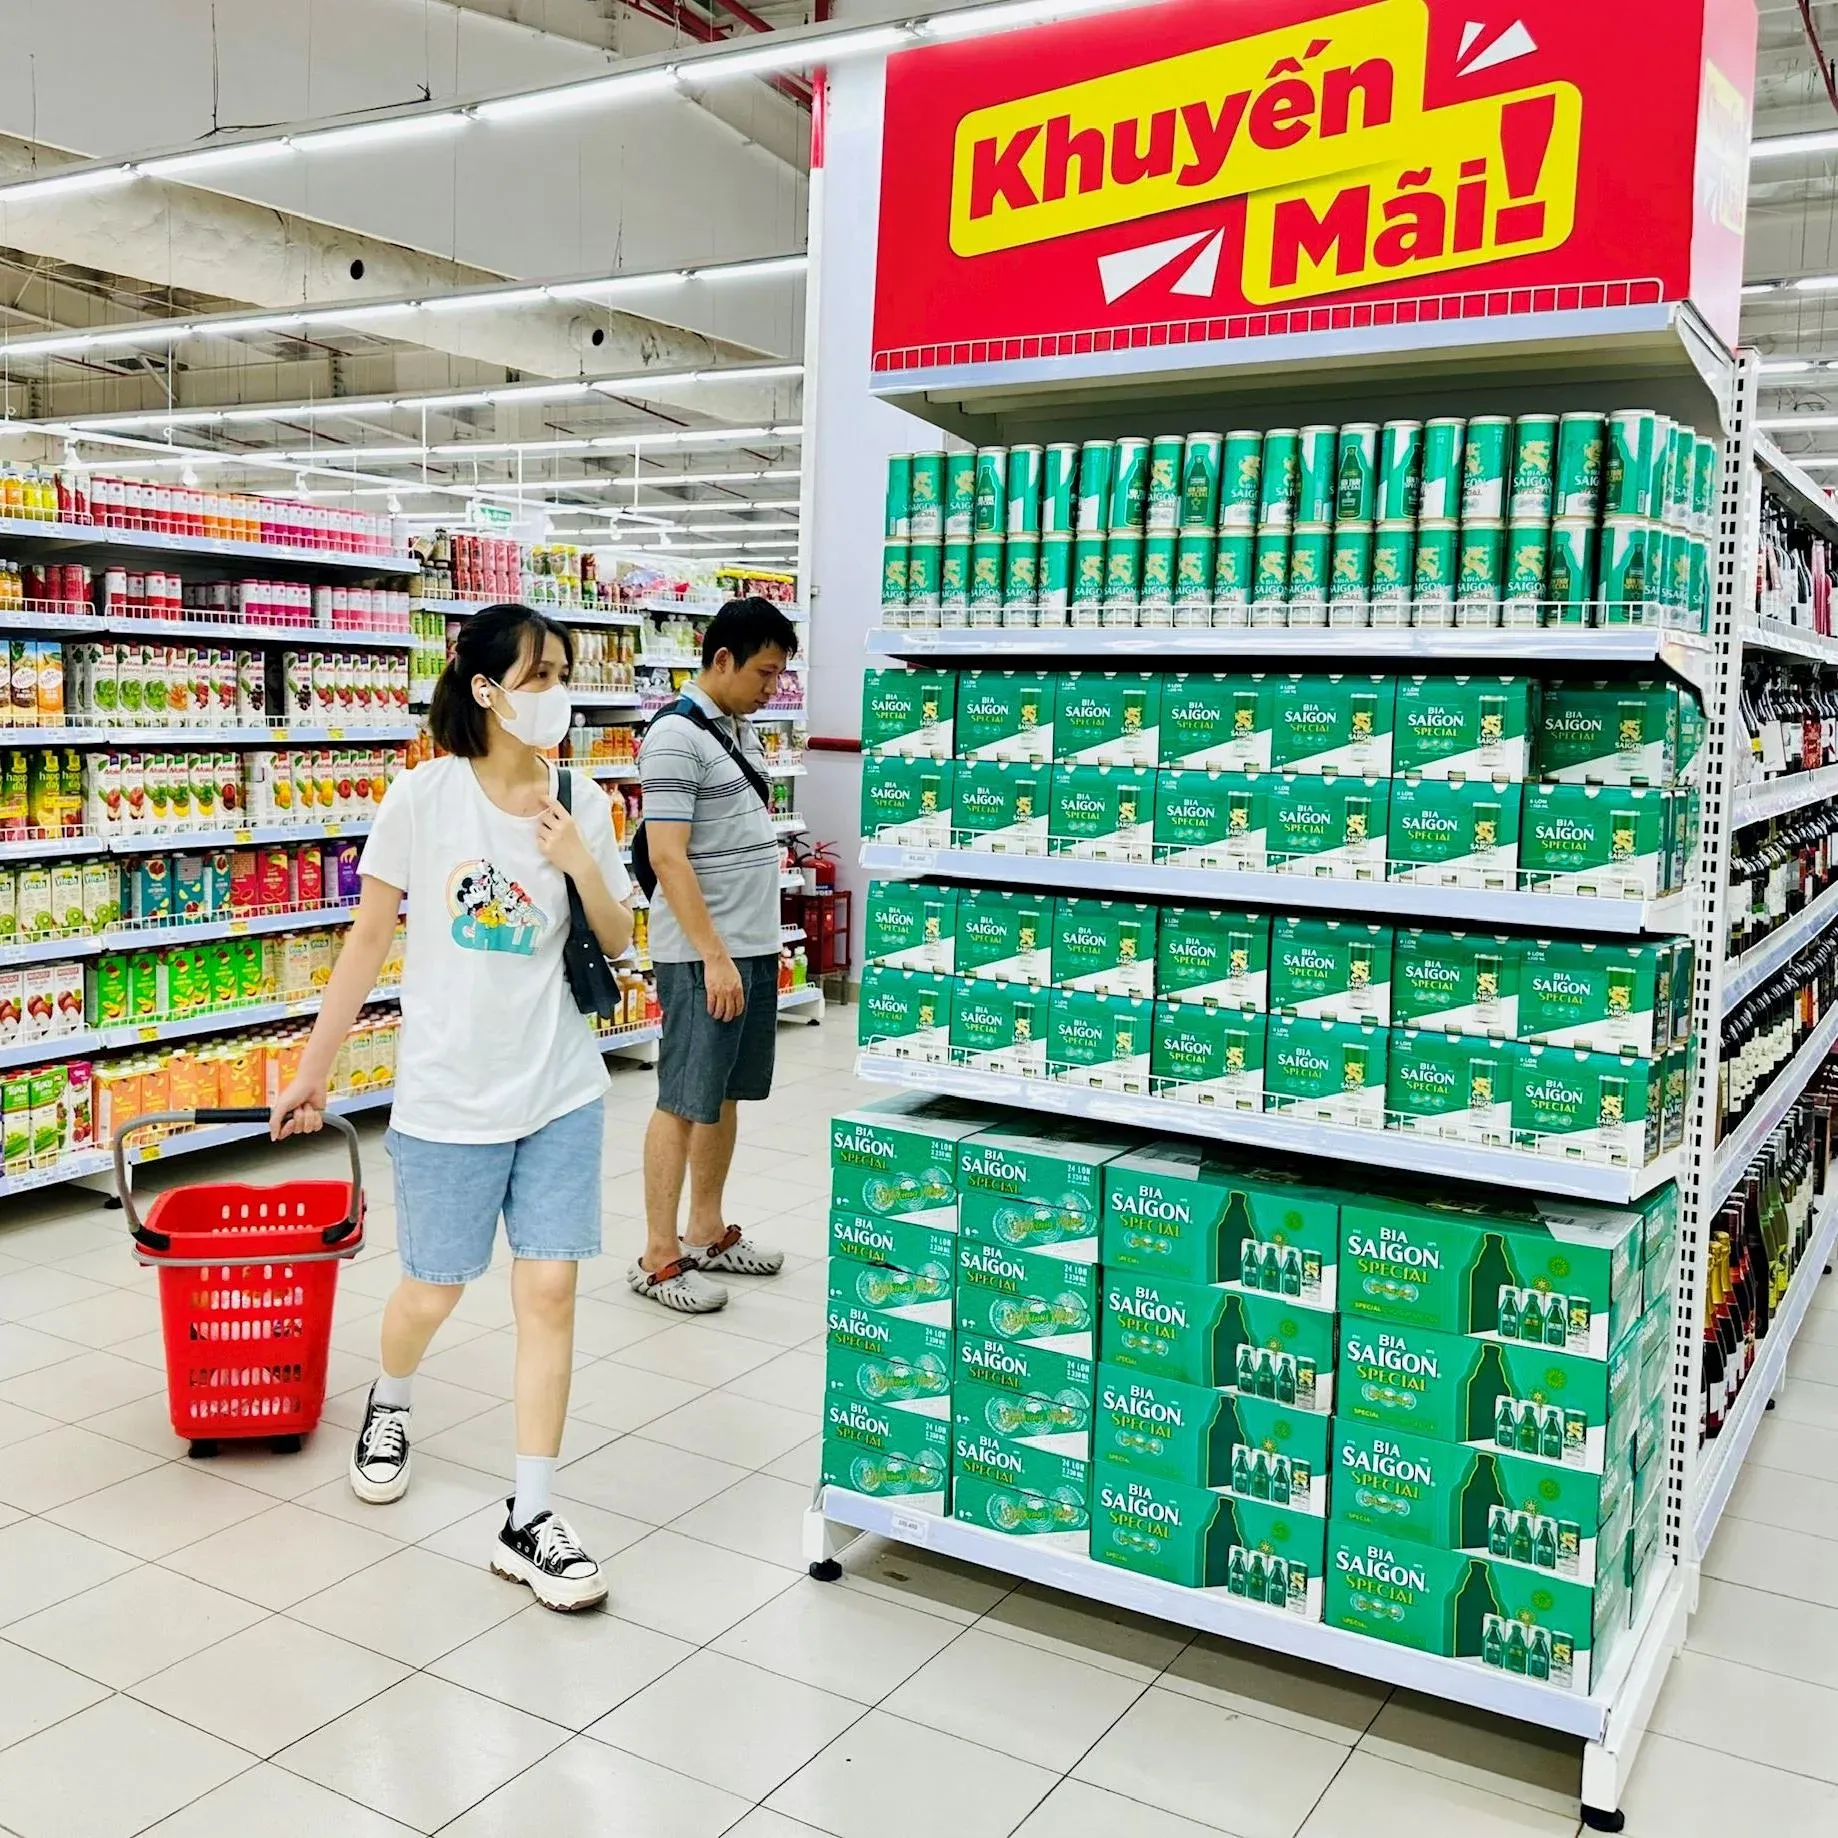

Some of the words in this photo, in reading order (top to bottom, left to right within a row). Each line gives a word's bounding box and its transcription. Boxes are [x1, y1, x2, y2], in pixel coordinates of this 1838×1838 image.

[968, 38, 1393, 219] Khuyến
[1268, 95, 1558, 288] Mãi!
[871, 700, 911, 711] SAIGON
[967, 703, 1008, 714] SAIGON
[1081, 699, 1095, 707] BIA
[1065, 706, 1111, 718] SAIGON
[1171, 708, 1220, 720] SAIGON
[1285, 710, 1336, 723] SAIGON
[1565, 711, 1582, 719] BIA
[1408, 713, 1463, 727] SAIGON
[1545, 718, 1602, 731] SAIGON
[871, 788, 910, 799] SAIGON
[962, 794, 1004, 806] SAIGON
[1060, 799, 1105, 811] SAIGON
[1167, 805, 1215, 817] SAIGON
[1279, 811, 1331, 824] SAIGON
[1402, 817, 1457, 830] SAIGON
[1556, 819, 1574, 827] BIA
[1536, 826, 1594, 840] SAIGON
[875, 912, 914, 925] SAIGON
[980, 916, 993, 924] BIA
[965, 922, 1007, 935] SAIGON
[1063, 932, 1106, 946] SAIGON
[1169, 943, 1216, 957] SAIGON
[1301, 949, 1317, 957] BIA
[1283, 954, 1334, 969] SAIGON
[1425, 960, 1441, 969] BIA
[1405, 966, 1460, 981] SAIGON
[1553, 973, 1571, 982] BIA
[1532, 978, 1591, 996] SAIGON
[881, 994, 894, 1002] BIA
[868, 999, 908, 1013] SAIGON
[975, 1006, 988, 1014] BIA
[961, 1012, 1002, 1025] SAIGON
[1073, 1019, 1087, 1027] BIA
[1058, 1025, 1102, 1039] SAIGON
[1164, 1039, 1212, 1054] SAIGON
[1296, 1048, 1311, 1057] BIA
[1278, 1054, 1329, 1070] SAIGON
[1420, 1063, 1437, 1071] BIA
[1400, 1067, 1455, 1085] SAIGON
[1545, 1080, 1564, 1089] BIA
[1525, 1085, 1583, 1104] SAIGON
[856, 1126, 873, 1138] BIA
[834, 1132, 894, 1158] SAIGON
[840, 1151, 888, 1169] SPECIAL
[985, 1150, 1004, 1162] BIA
[962, 1156, 1027, 1182] SAIGON
[968, 1175, 1020, 1194] SPECIAL
[1139, 1185, 1163, 1200] BIA
[1112, 1193, 1191, 1224] SAIGON
[855, 1217, 873, 1230] BIA
[1120, 1214, 1181, 1237] SPECIAL
[834, 1223, 894, 1251] SAIGON
[1380, 1227, 1408, 1244] BIA
[840, 1243, 886, 1261] SPECIAL
[983, 1245, 1002, 1260] BIA
[1348, 1236, 1441, 1269] SAIGON
[960, 1252, 1025, 1280] SAIGON
[1358, 1260, 1430, 1283] SPECIAL
[967, 1271, 1018, 1292] SPECIAL
[1136, 1287, 1159, 1302] BIA
[850, 1309, 868, 1322] BIA
[1110, 1293, 1186, 1328] SAIGON
[829, 1314, 889, 1342] SAIGON
[1117, 1315, 1177, 1339] SPECIAL
[835, 1333, 883, 1353] SPECIAL
[984, 1341, 1005, 1354] BIA
[1378, 1334, 1406, 1350] BIA
[962, 1347, 1028, 1376] SAIGON
[1347, 1342, 1438, 1378] SAIGON
[968, 1367, 1021, 1388] SPECIAL
[1356, 1365, 1427, 1391] SPECIAL
[1130, 1385, 1154, 1400] BIA
[850, 1403, 868, 1416] BIA
[1103, 1391, 1182, 1426] SAIGON
[830, 1408, 889, 1436] SAIGON
[1111, 1413, 1173, 1438] SPECIAL
[836, 1426, 882, 1447] SPECIAL
[979, 1436, 999, 1450] BIA
[957, 1440, 1022, 1472] SAIGON
[1373, 1439, 1400, 1458] BIA
[963, 1461, 1014, 1484] SPECIAL
[1342, 1446, 1432, 1485] SAIGON
[1128, 1483, 1152, 1500] BIA
[1351, 1471, 1422, 1499] SPECIAL
[1101, 1489, 1180, 1526] SAIGON
[1109, 1512, 1171, 1538] SPECIAL
[1367, 1546, 1396, 1563] BIA
[1336, 1551, 1425, 1592] SAIGON
[1345, 1575, 1415, 1604] SPECIAL
